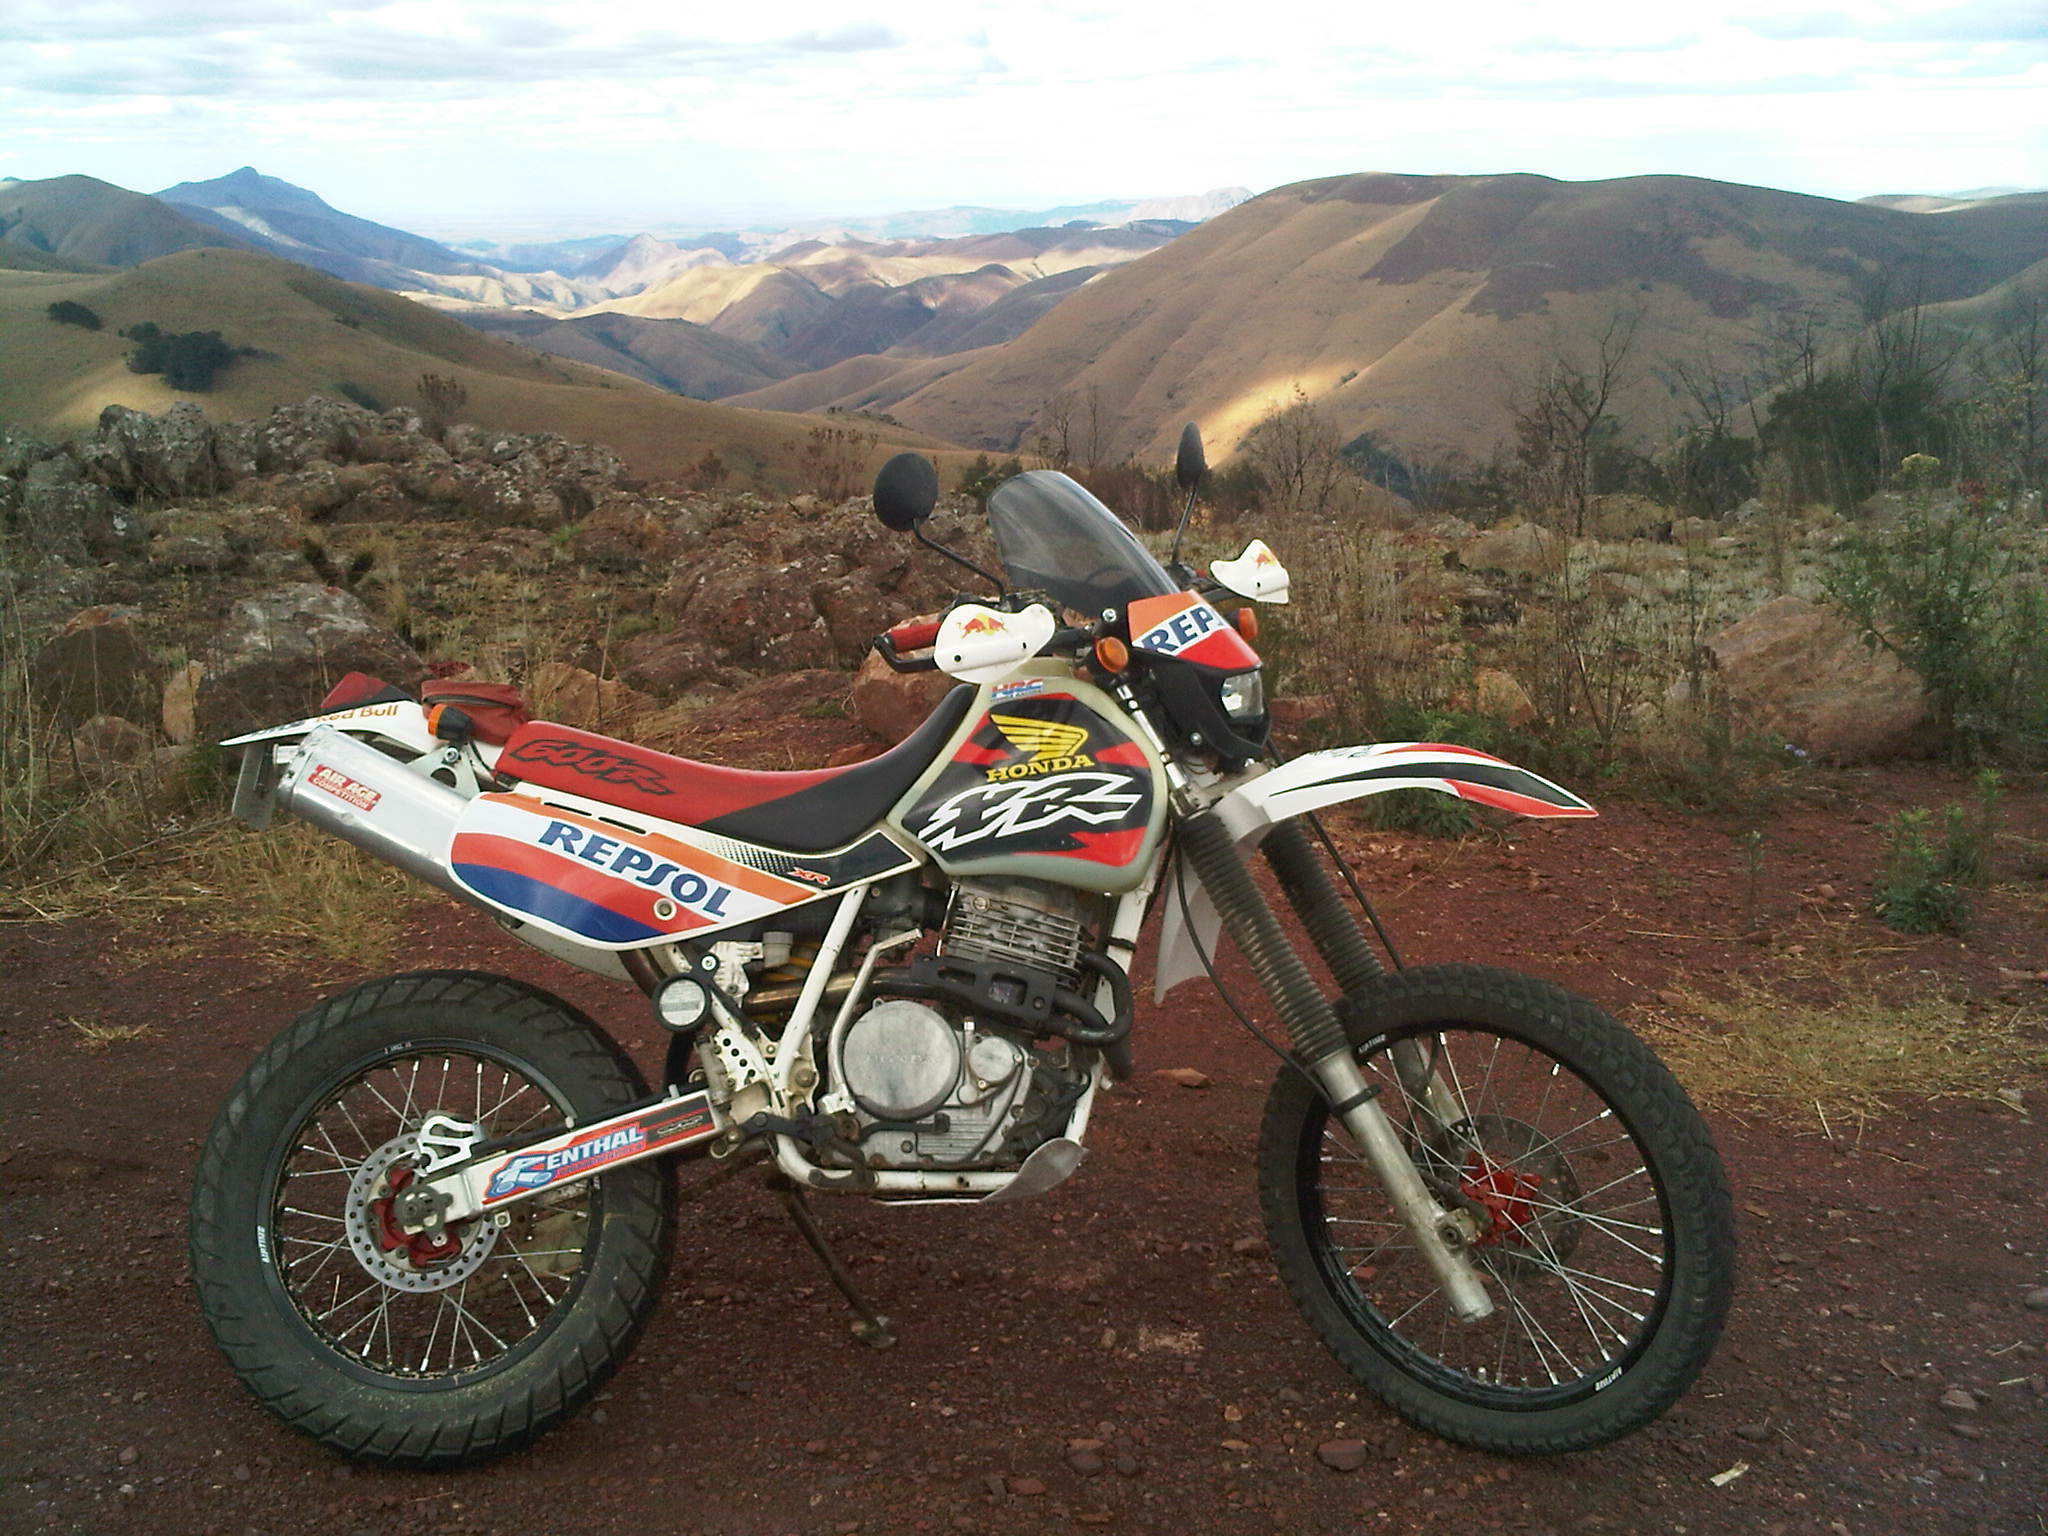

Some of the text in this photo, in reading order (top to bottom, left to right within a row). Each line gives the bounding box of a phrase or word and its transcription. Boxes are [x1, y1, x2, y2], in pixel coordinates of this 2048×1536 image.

[359, 704, 399, 718] Bull
[317, 767, 378, 801] AIR AGE
[986, 753, 1095, 783] HONDA
[312, 776, 369, 810] COMPETITION
[538, 819, 732, 918] REPSOL
[787, 866, 831, 886] XR
